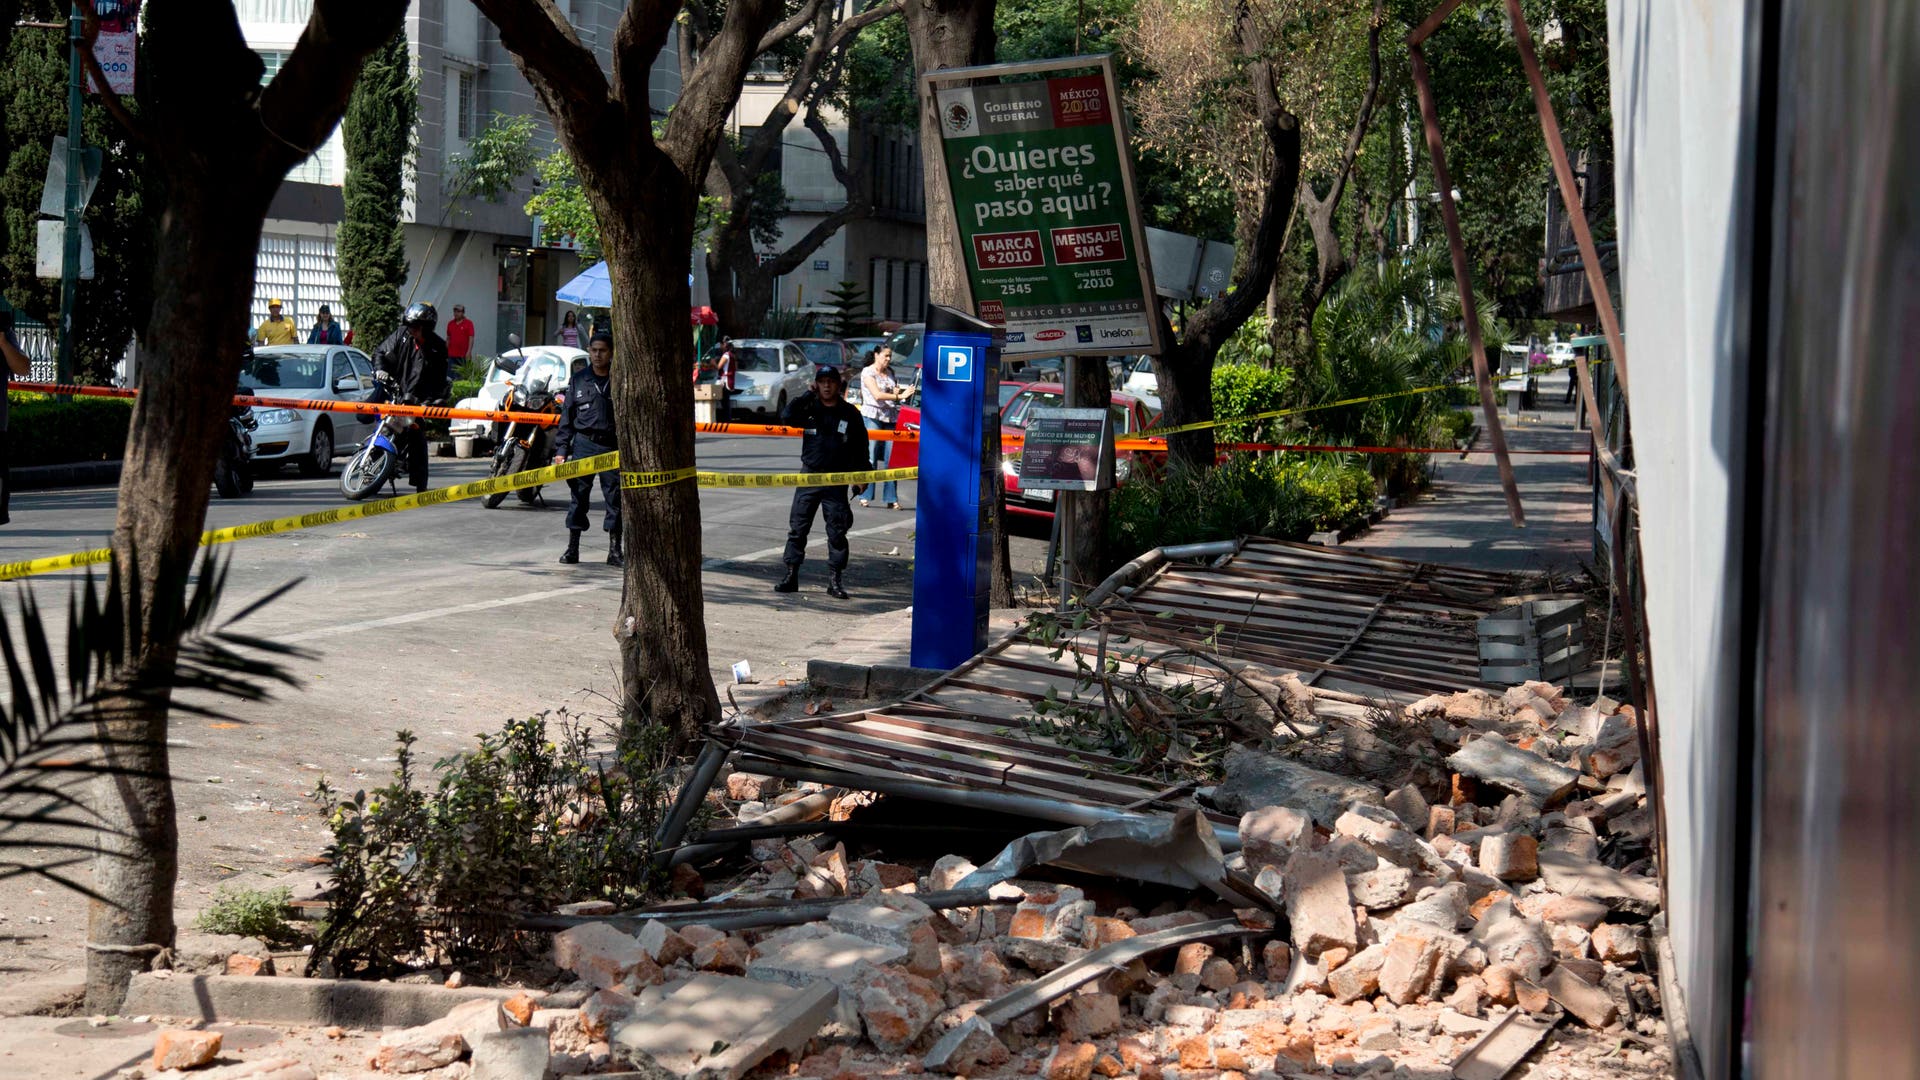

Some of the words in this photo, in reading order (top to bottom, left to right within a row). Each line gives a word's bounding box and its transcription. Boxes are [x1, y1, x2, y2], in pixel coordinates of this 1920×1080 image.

[1060, 88, 1100, 100] MÉXICO
[1061, 99, 1101, 114] 2010
[990, 112, 1040, 123] FEDERAL
[962, 140, 1096, 179] ¿Quieres
[994, 172, 1045, 193] saber
[1048, 167, 1084, 193] qué
[974, 190, 1034, 227] pasó
[1040, 181, 1112, 221] aquí?
[981, 237, 1035, 252] MARCA
[1054, 230, 1120, 247] MENSAJE
[1074, 245, 1105, 259] SMS
[1090, 268, 1112, 277] BEDE
[1000, 283, 1032, 295] 2545
[1083, 277, 1115, 290] 2010
[981, 304, 1002, 313] RUTA
[1010, 307, 1054, 318] MÉXICO
[1060, 307, 1073, 315] ES
[1079, 305, 1093, 314] MI
[1100, 302, 1139, 312] MUSEO
[982, 313, 1004, 321] 2010
[1100, 328, 1134, 339] Unefon
[947, 351, 968, 375] P
